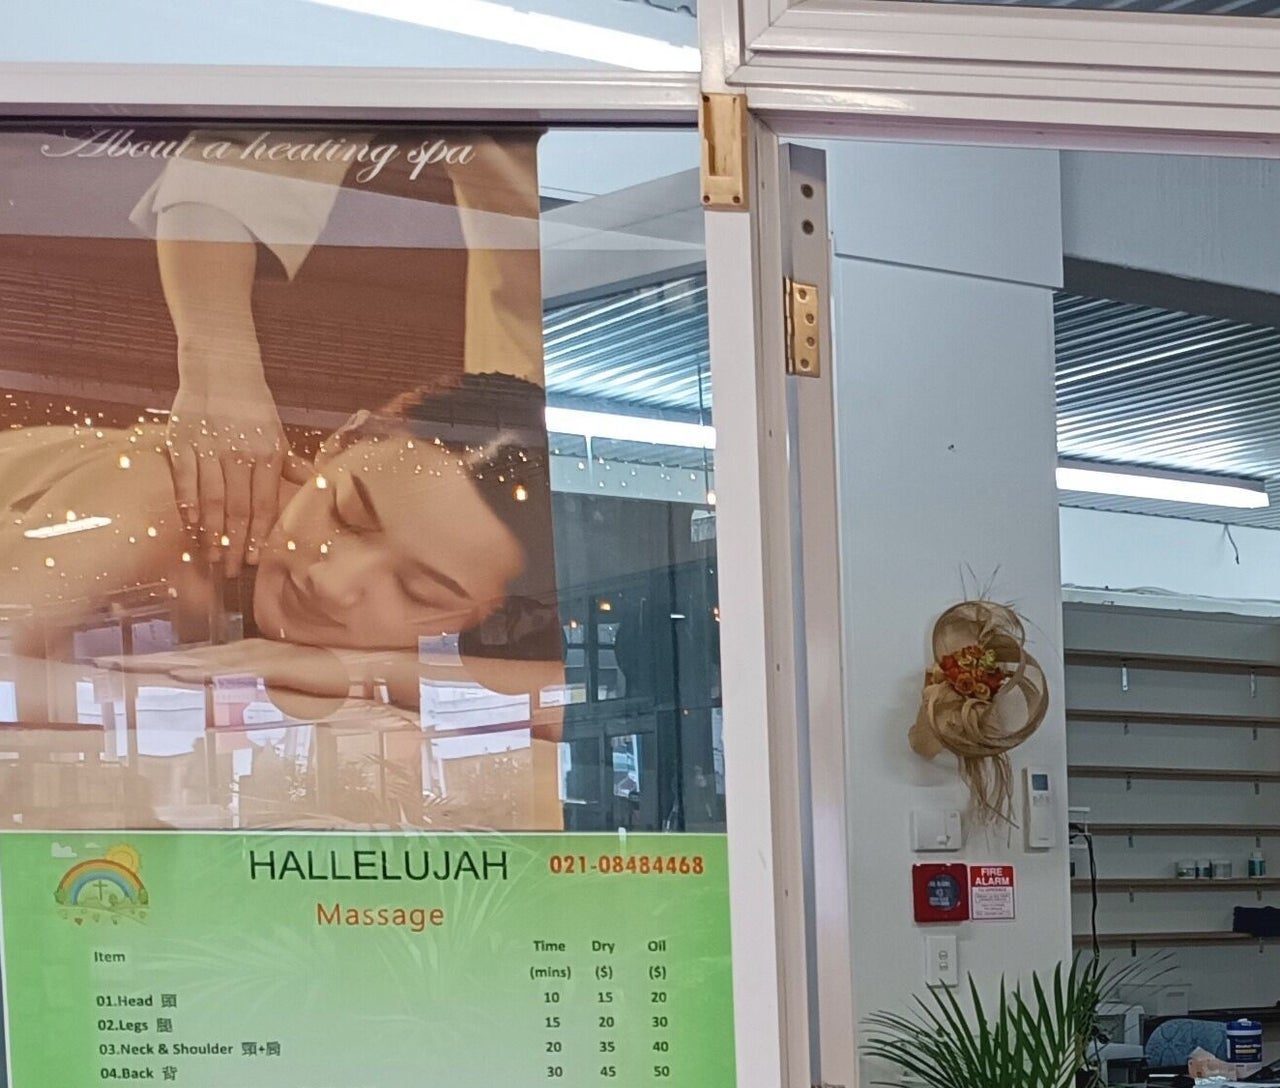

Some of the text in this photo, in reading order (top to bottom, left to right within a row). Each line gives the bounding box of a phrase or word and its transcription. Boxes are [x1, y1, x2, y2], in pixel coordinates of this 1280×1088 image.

[41, 128, 196, 159] About
[202, 140, 231, 159] a
[407, 139, 475, 180] spa
[249, 850, 705, 882] HALLELUJAH 021-08484468
[981, 867, 1003, 876] FIRE
[975, 877, 1010, 886] ALARM
[316, 903, 445, 931] Massage
[533, 940, 667, 955] Time Dry Oil
[95, 951, 126, 963] Item
[529, 966, 667, 980] (mins) ($) ($)
[95, 996, 154, 1007] 01.Head
[544, 991, 668, 1004] 10 15 20
[97, 1020, 149, 1034] 02.Legs
[545, 1016, 669, 1029] 15 20 30
[98, 1043, 234, 1055] 03.Neck & Shoulder
[545, 1041, 670, 1053] 20 35 40
[100, 1068, 155, 1080] 04.Back
[547, 1065, 671, 1078] 30 45 50
